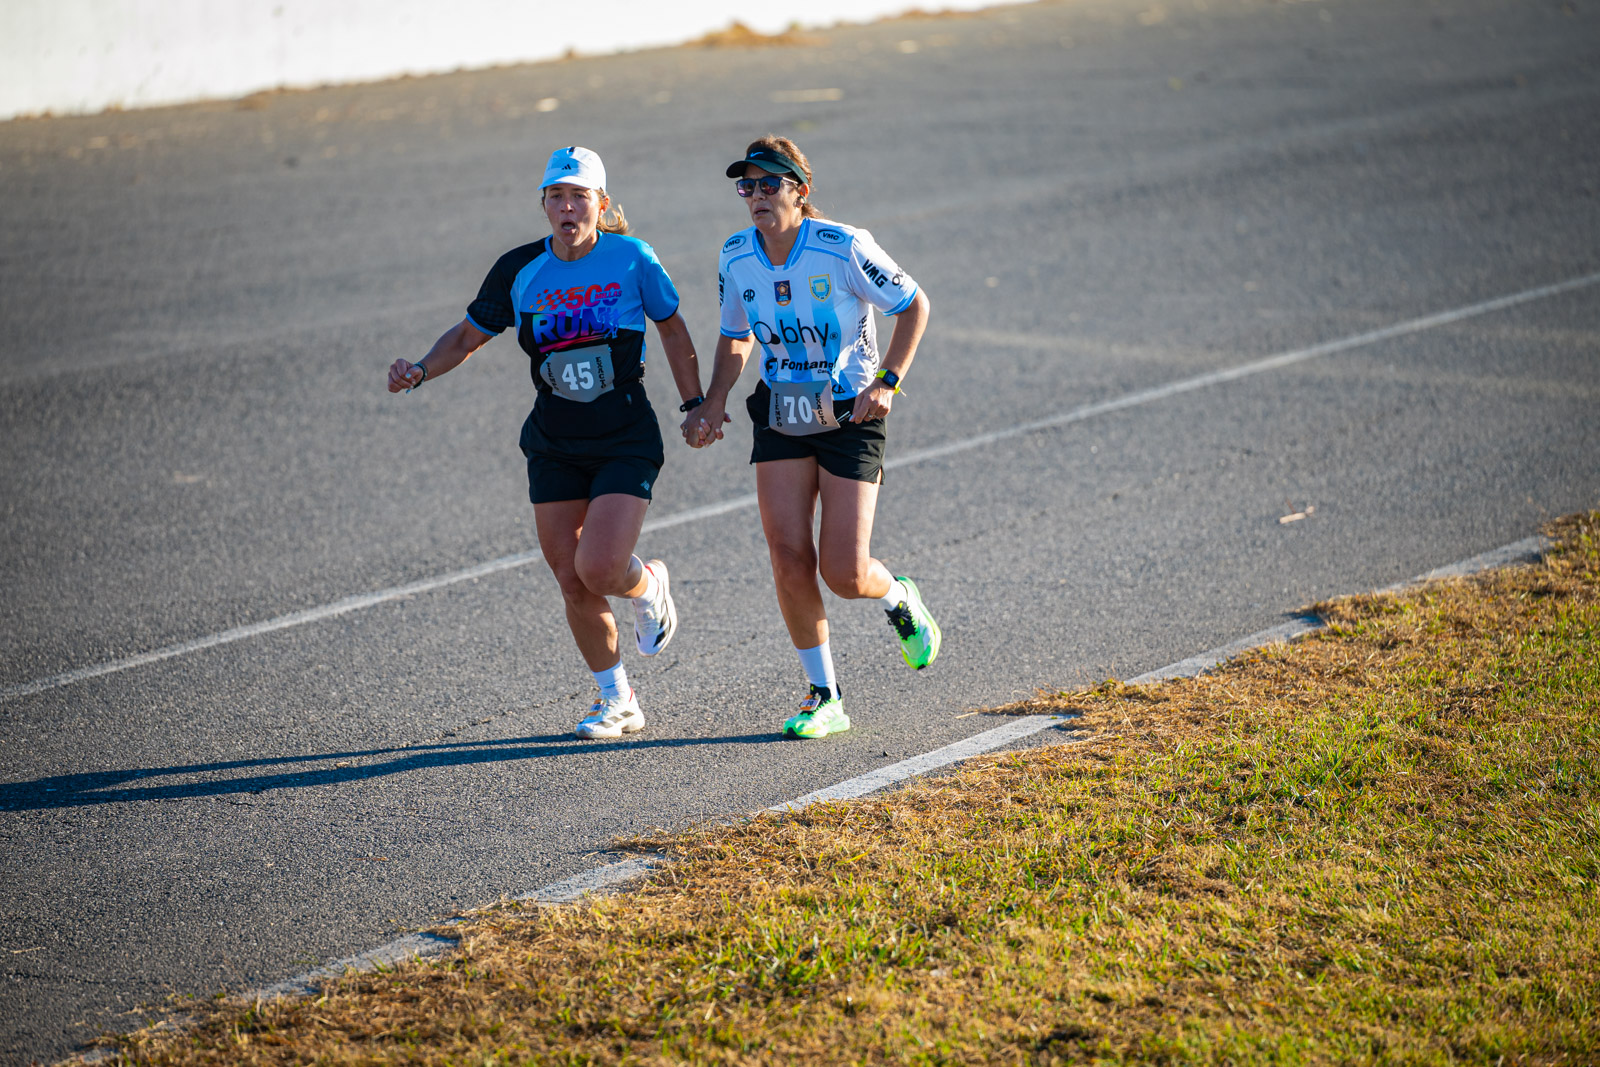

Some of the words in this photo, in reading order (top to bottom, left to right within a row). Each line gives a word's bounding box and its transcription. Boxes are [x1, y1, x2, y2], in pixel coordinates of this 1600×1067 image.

[862, 259, 888, 288] VMG
[561, 361, 594, 390] 45
[774, 393, 782, 427] TIEMPO
[783, 396, 813, 424] 70
[815, 392, 827, 425] EXACTO
